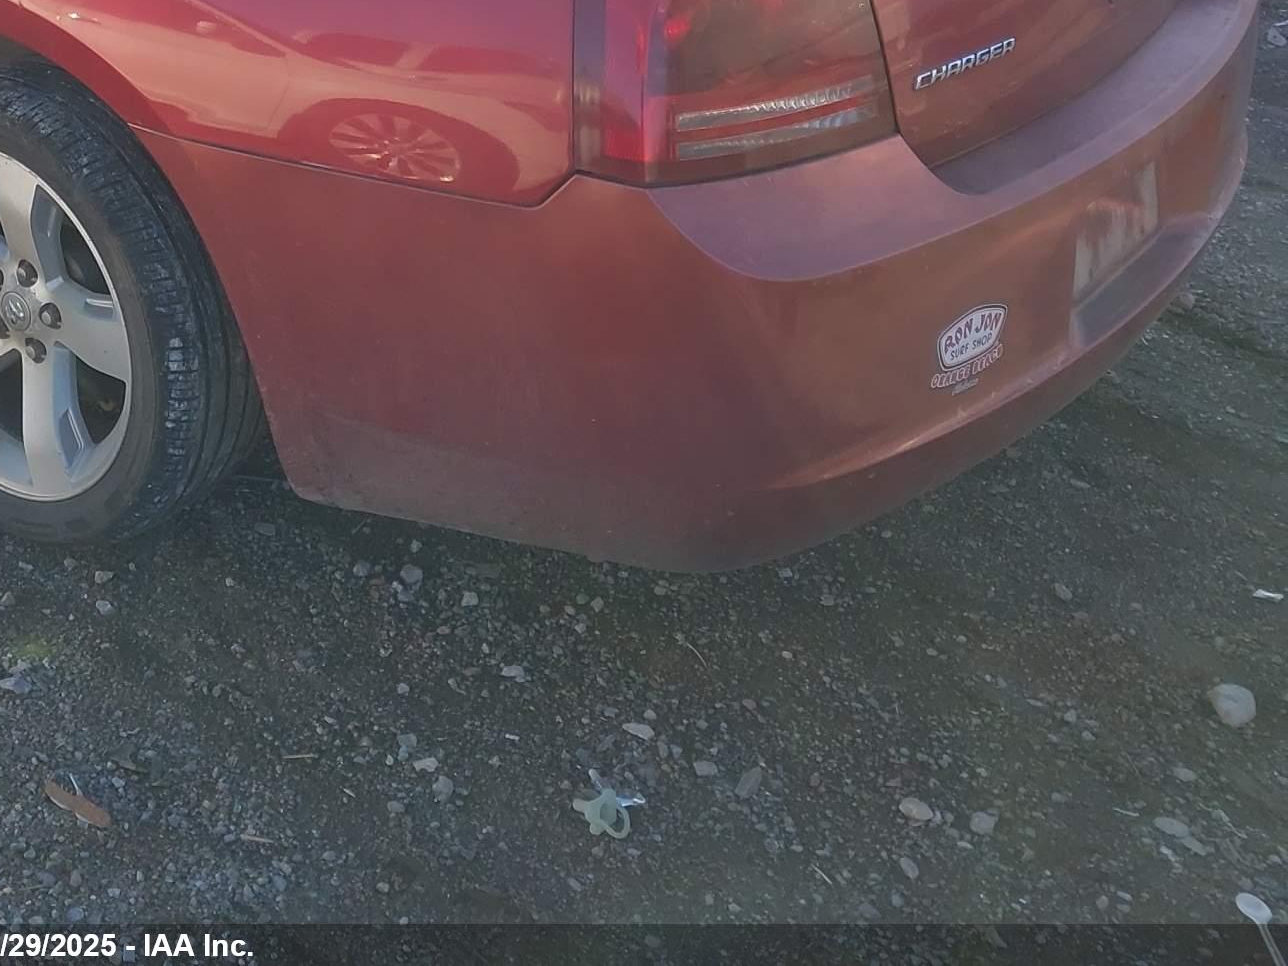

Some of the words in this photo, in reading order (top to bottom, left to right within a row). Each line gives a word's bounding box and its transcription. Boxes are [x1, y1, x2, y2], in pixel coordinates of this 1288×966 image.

[915, 37, 1016, 90] CHARGER
[944, 318, 974, 355] RON
[975, 312, 1002, 333] JON
[950, 342, 970, 361] SURF
[972, 332, 993, 350] SHOP
